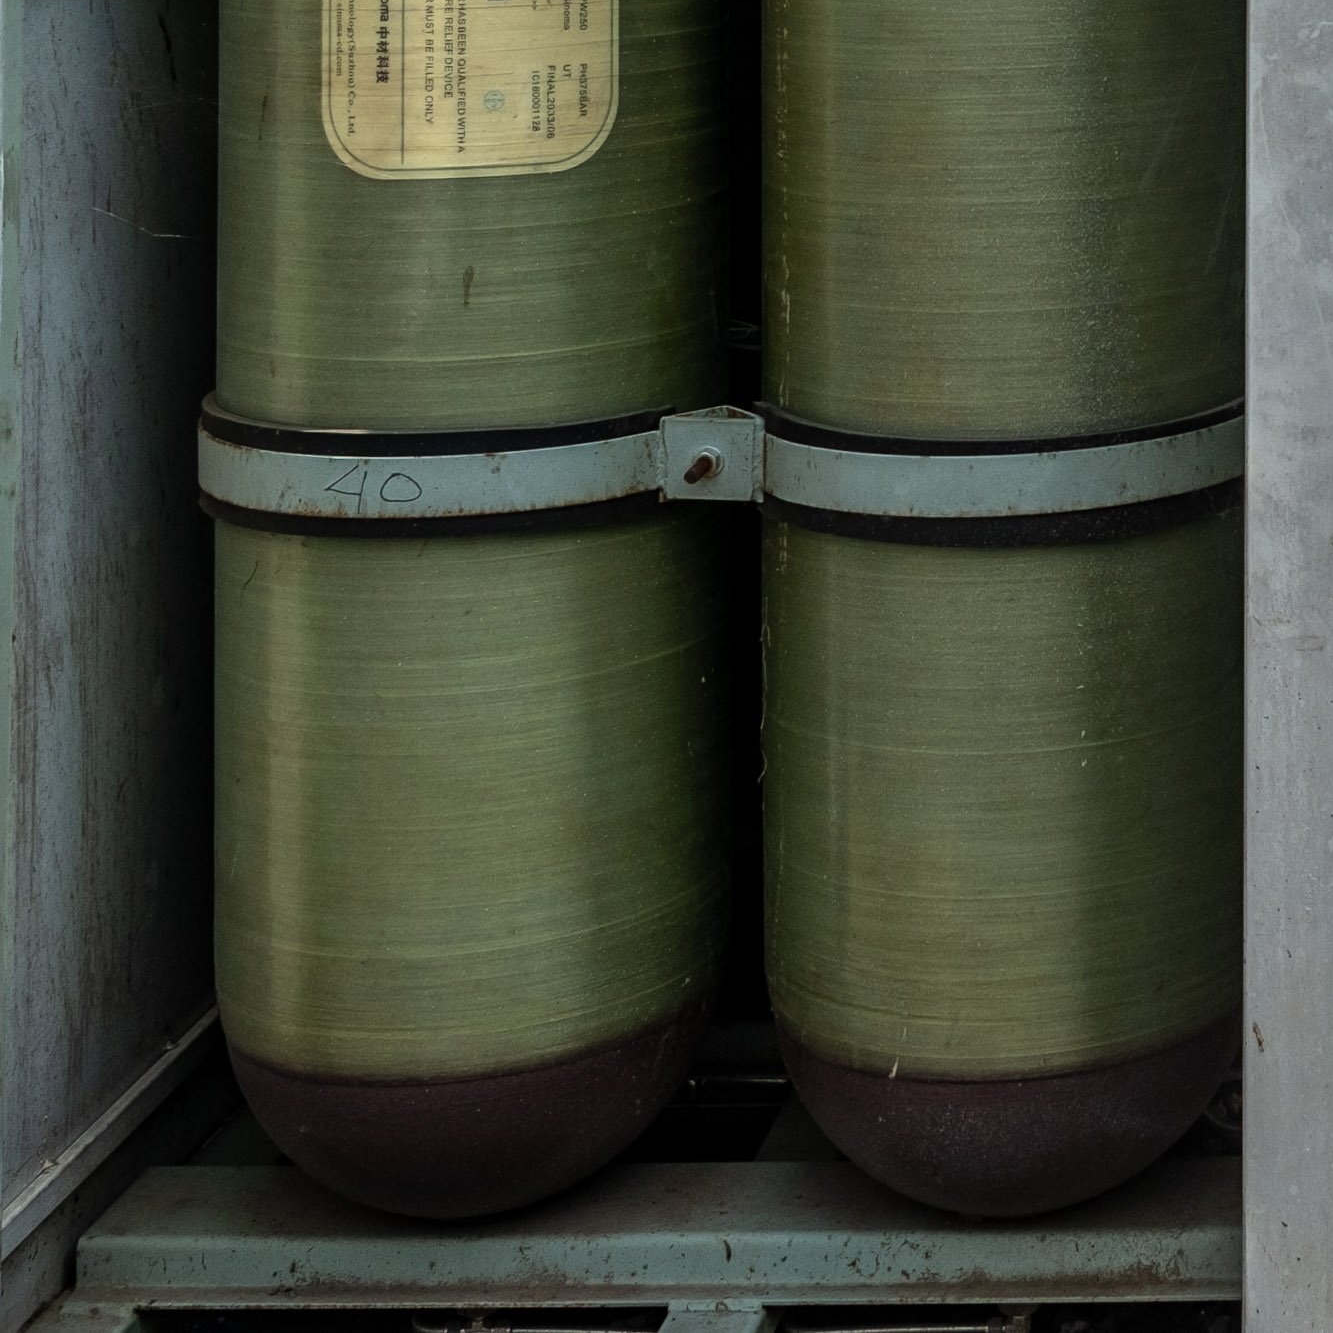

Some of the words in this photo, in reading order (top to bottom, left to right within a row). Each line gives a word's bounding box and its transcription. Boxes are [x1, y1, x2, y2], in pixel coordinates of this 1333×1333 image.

[425, 5, 434, 35] MUST
[457, 3, 466, 27] HAS
[425, 39, 434, 53] BE
[444, 17, 454, 55] RELIEF
[457, 26, 466, 55] BEEN
[376, 26, 390, 84] 中材科技
[425, 56, 434, 92] FILLED
[444, 57, 454, 98] DEVICE
[457, 58, 466, 115] QUALIFIED
[425, 95, 434, 125] ONLY
[456, 117, 466, 144] WITH
[324, 464, 422, 513] 40
